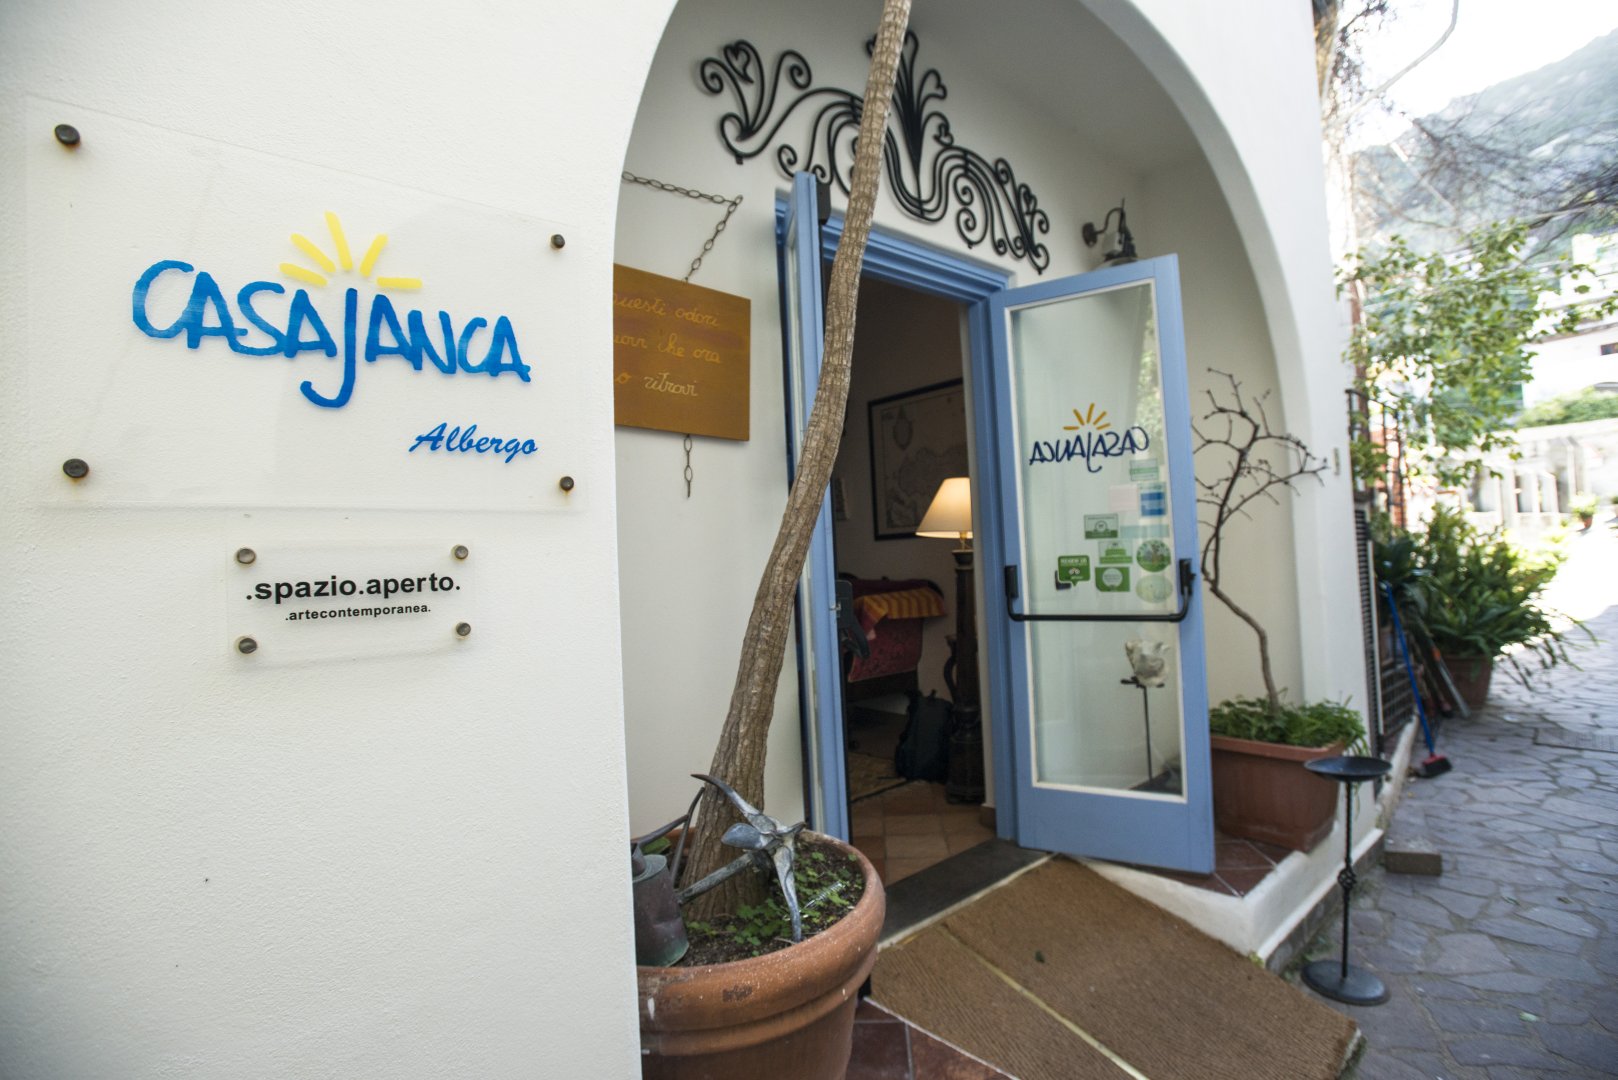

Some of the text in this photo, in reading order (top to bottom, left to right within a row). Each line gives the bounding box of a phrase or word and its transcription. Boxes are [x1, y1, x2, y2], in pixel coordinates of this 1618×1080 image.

[674, 307, 720, 327] odori
[133, 260, 531, 409] CASAJANCA
[692, 346, 721, 364] ora
[643, 369, 699, 397] ritrovi
[409, 423, 537, 463] Albergo
[245, 573, 461, 605] .spazio.aperto.
[285, 603, 432, 621] .artecontemporanea.
